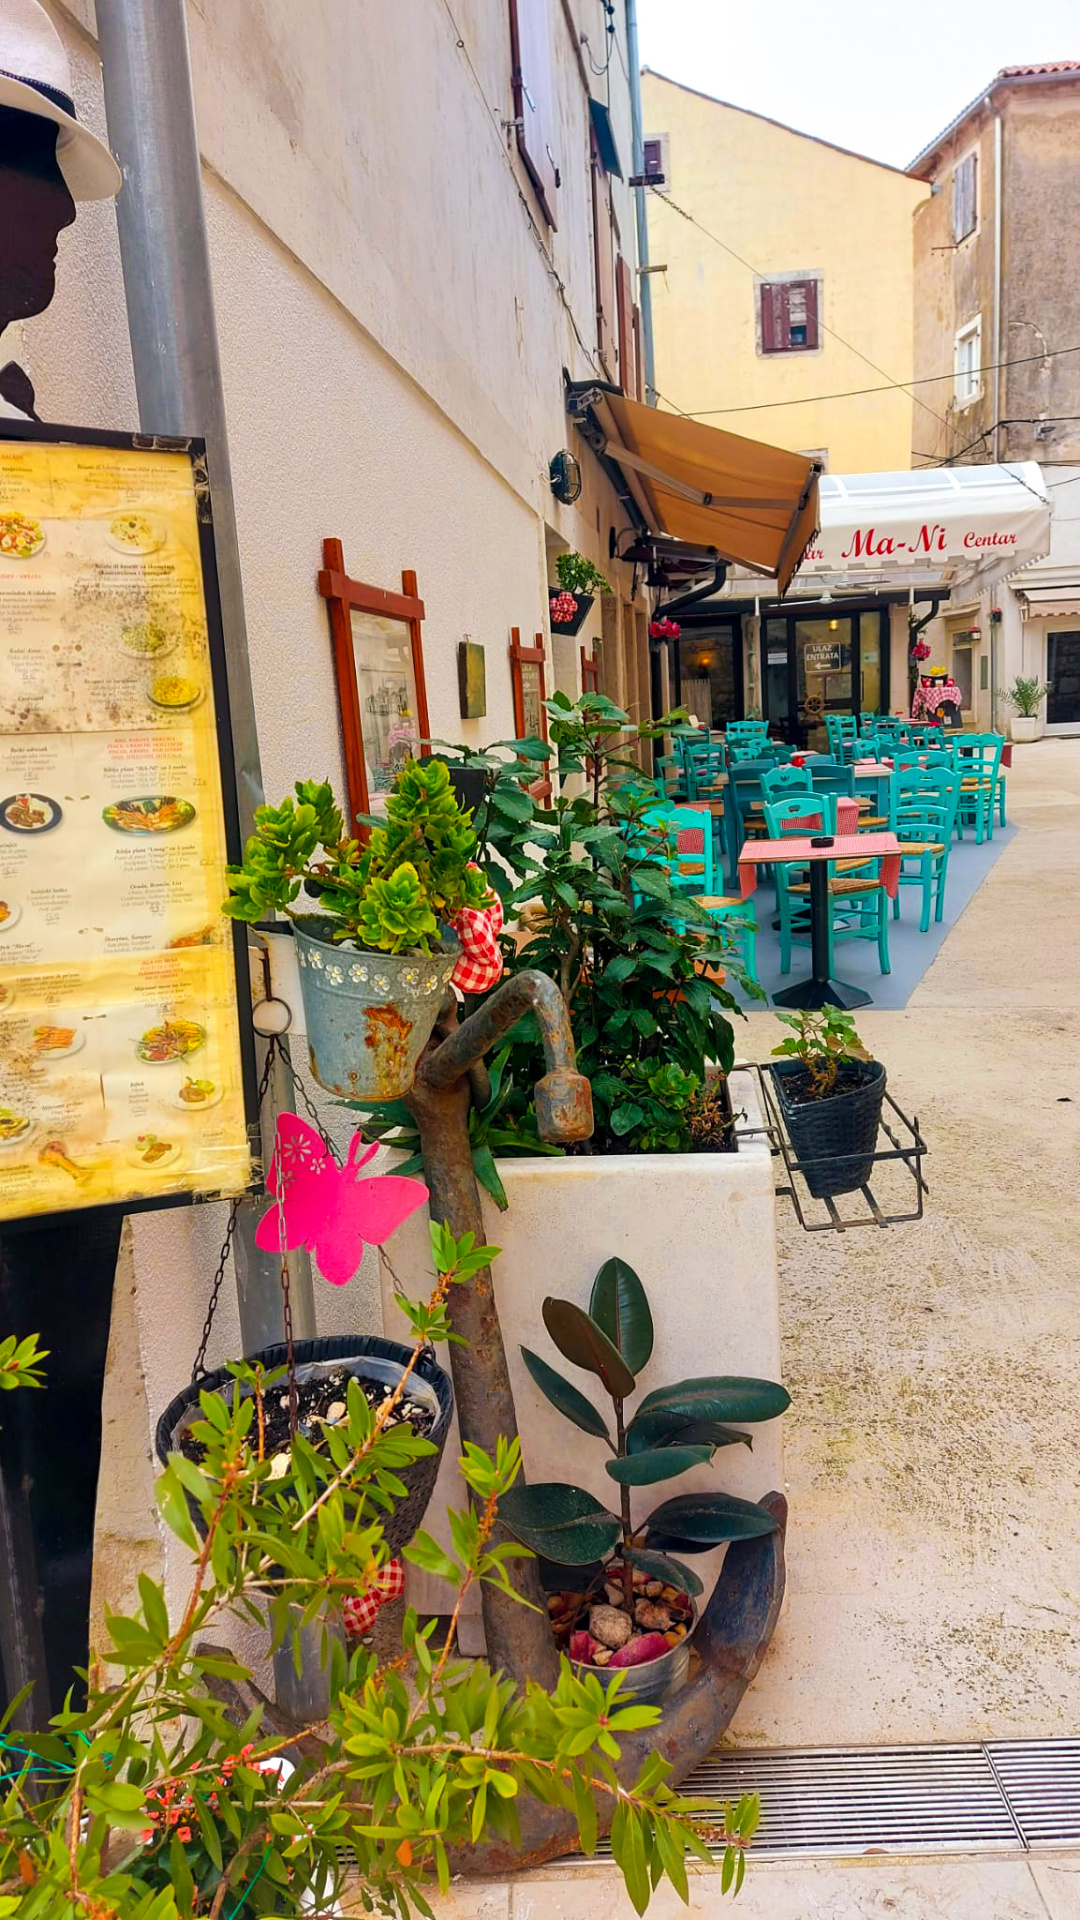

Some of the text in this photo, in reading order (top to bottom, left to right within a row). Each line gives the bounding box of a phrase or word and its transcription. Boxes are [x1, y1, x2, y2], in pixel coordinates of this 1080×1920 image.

[841, 524, 1017, 558] Ma-Ni Centar
[812, 644, 833, 653] ULAZ
[806, 652, 839, 661] ENTRATA
